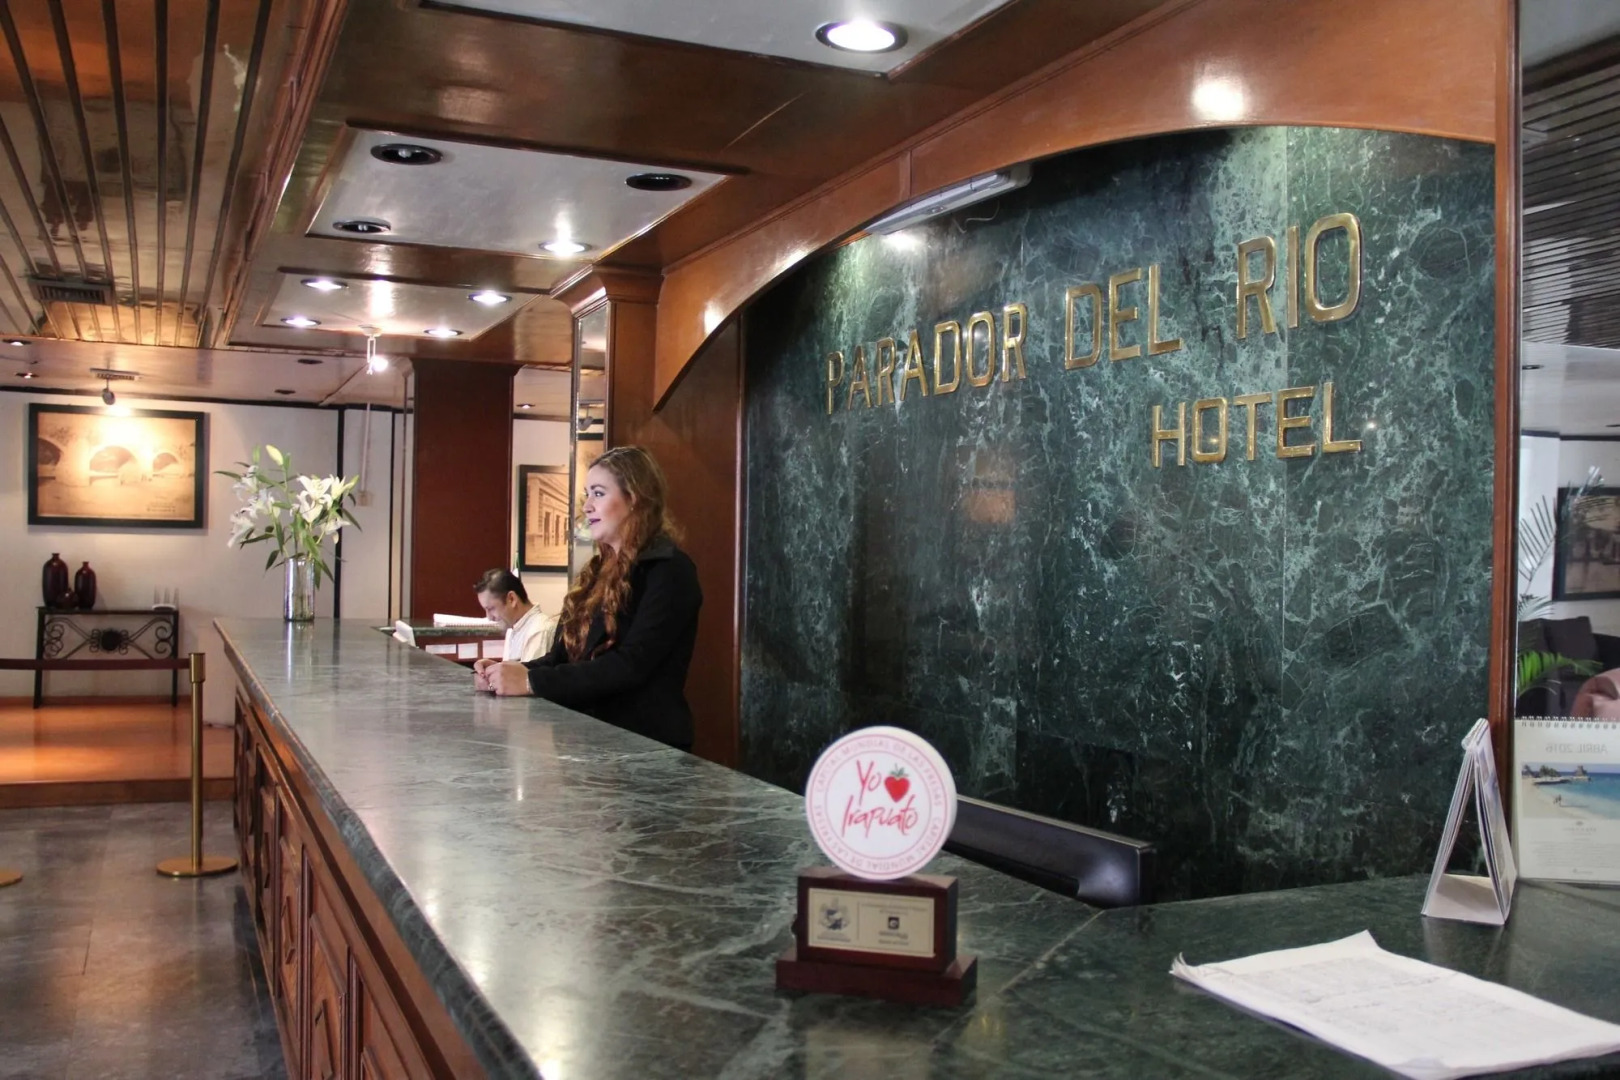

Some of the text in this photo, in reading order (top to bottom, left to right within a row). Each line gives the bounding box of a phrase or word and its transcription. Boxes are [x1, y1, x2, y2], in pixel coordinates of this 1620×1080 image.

[825, 212, 1361, 414] PARADOR DEL RIO
[1150, 381, 1362, 468] HOTEL
[814, 754, 840, 793] CAPITAL
[838, 738, 889, 757] MUNDIAL
[906, 748, 926, 767] LAS
[856, 760, 881, 806] Yo
[841, 794, 918, 839] Irapuato
